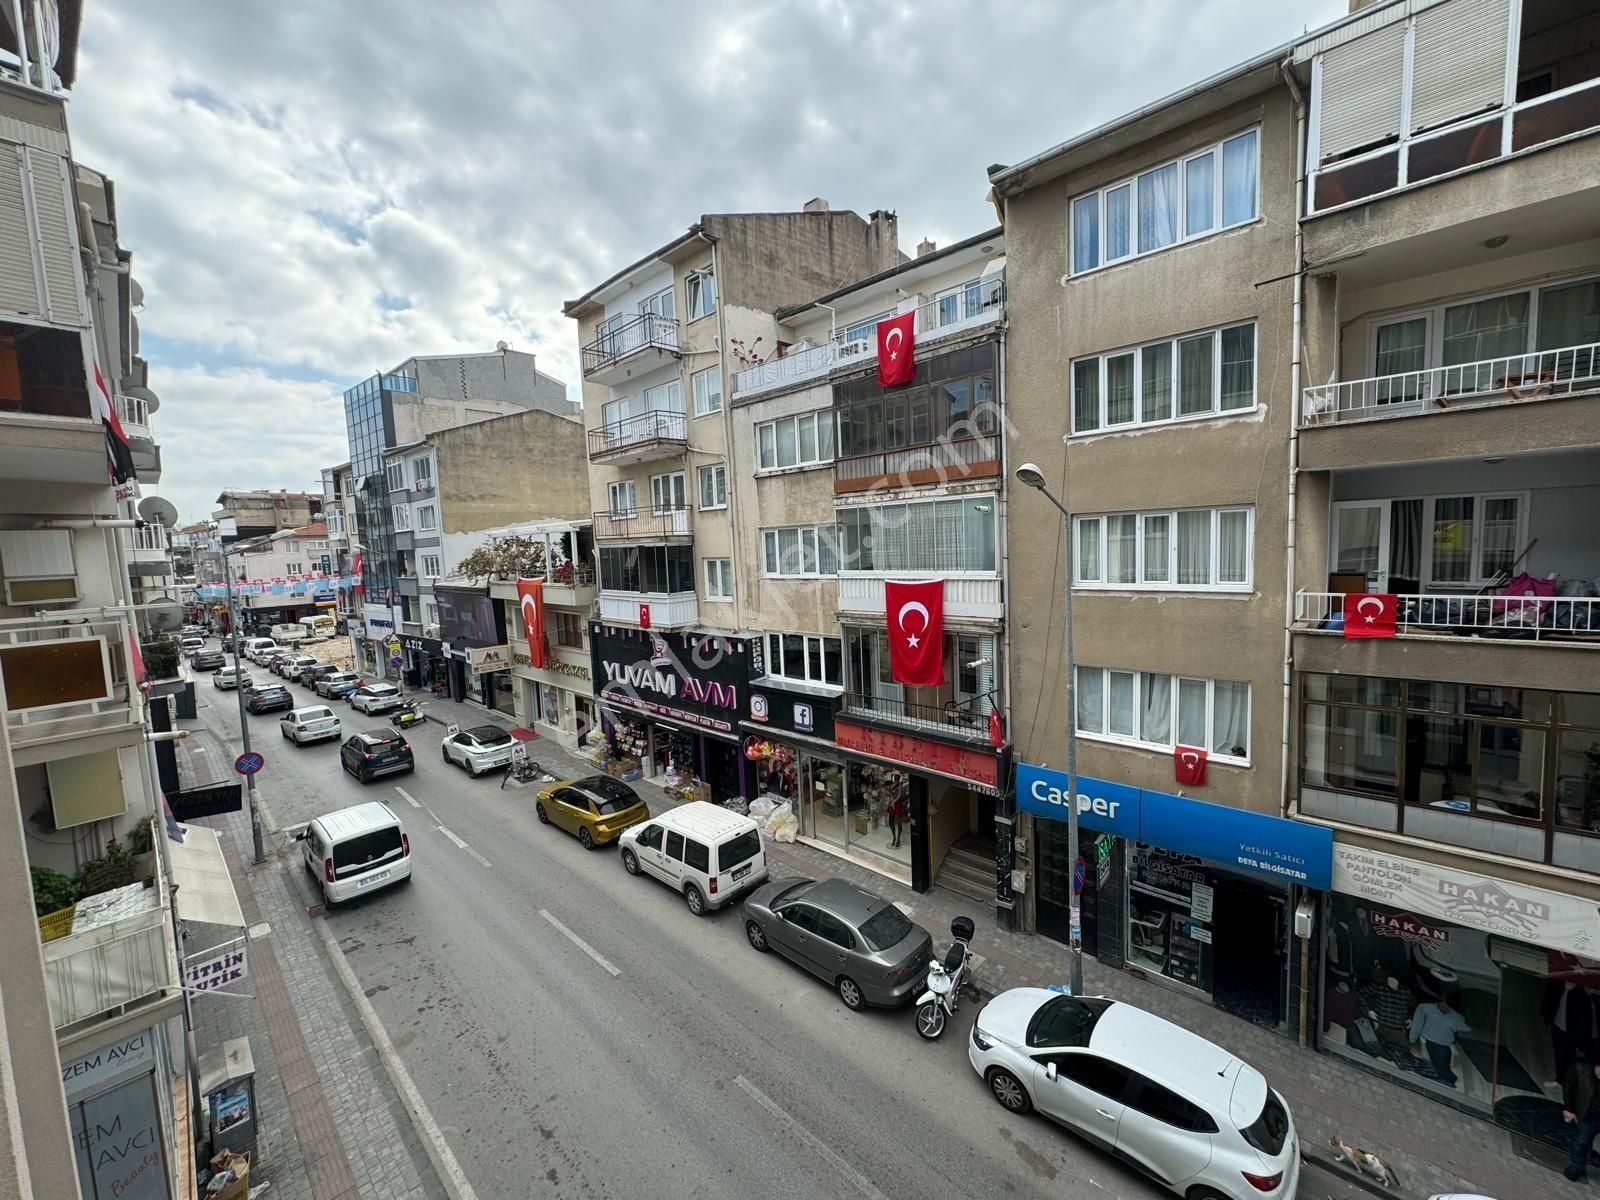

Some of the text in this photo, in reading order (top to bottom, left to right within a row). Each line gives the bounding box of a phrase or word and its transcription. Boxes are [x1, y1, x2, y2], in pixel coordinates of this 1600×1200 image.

[602, 660, 677, 697] YUVAM
[680, 677, 737, 710] AVM
[1031, 780, 1120, 818] Casper
[1237, 856, 1308, 880] DEFA BİLGİSAYAR
[1338, 850, 1374, 865] TAKIM
[1346, 862, 1411, 884] PANTOLON
[1352, 873, 1403, 892] GÖMLEK
[1361, 885, 1395, 899] MONT
[1442, 882, 1543, 918] HAKAN
[1374, 914, 1446, 942] HAKAN
[107, 1036, 144, 1063] AVCI
[72, 1114, 121, 1151] EM
[97, 1126, 155, 1171] AVCI
[109, 1150, 160, 1198] Beauty
